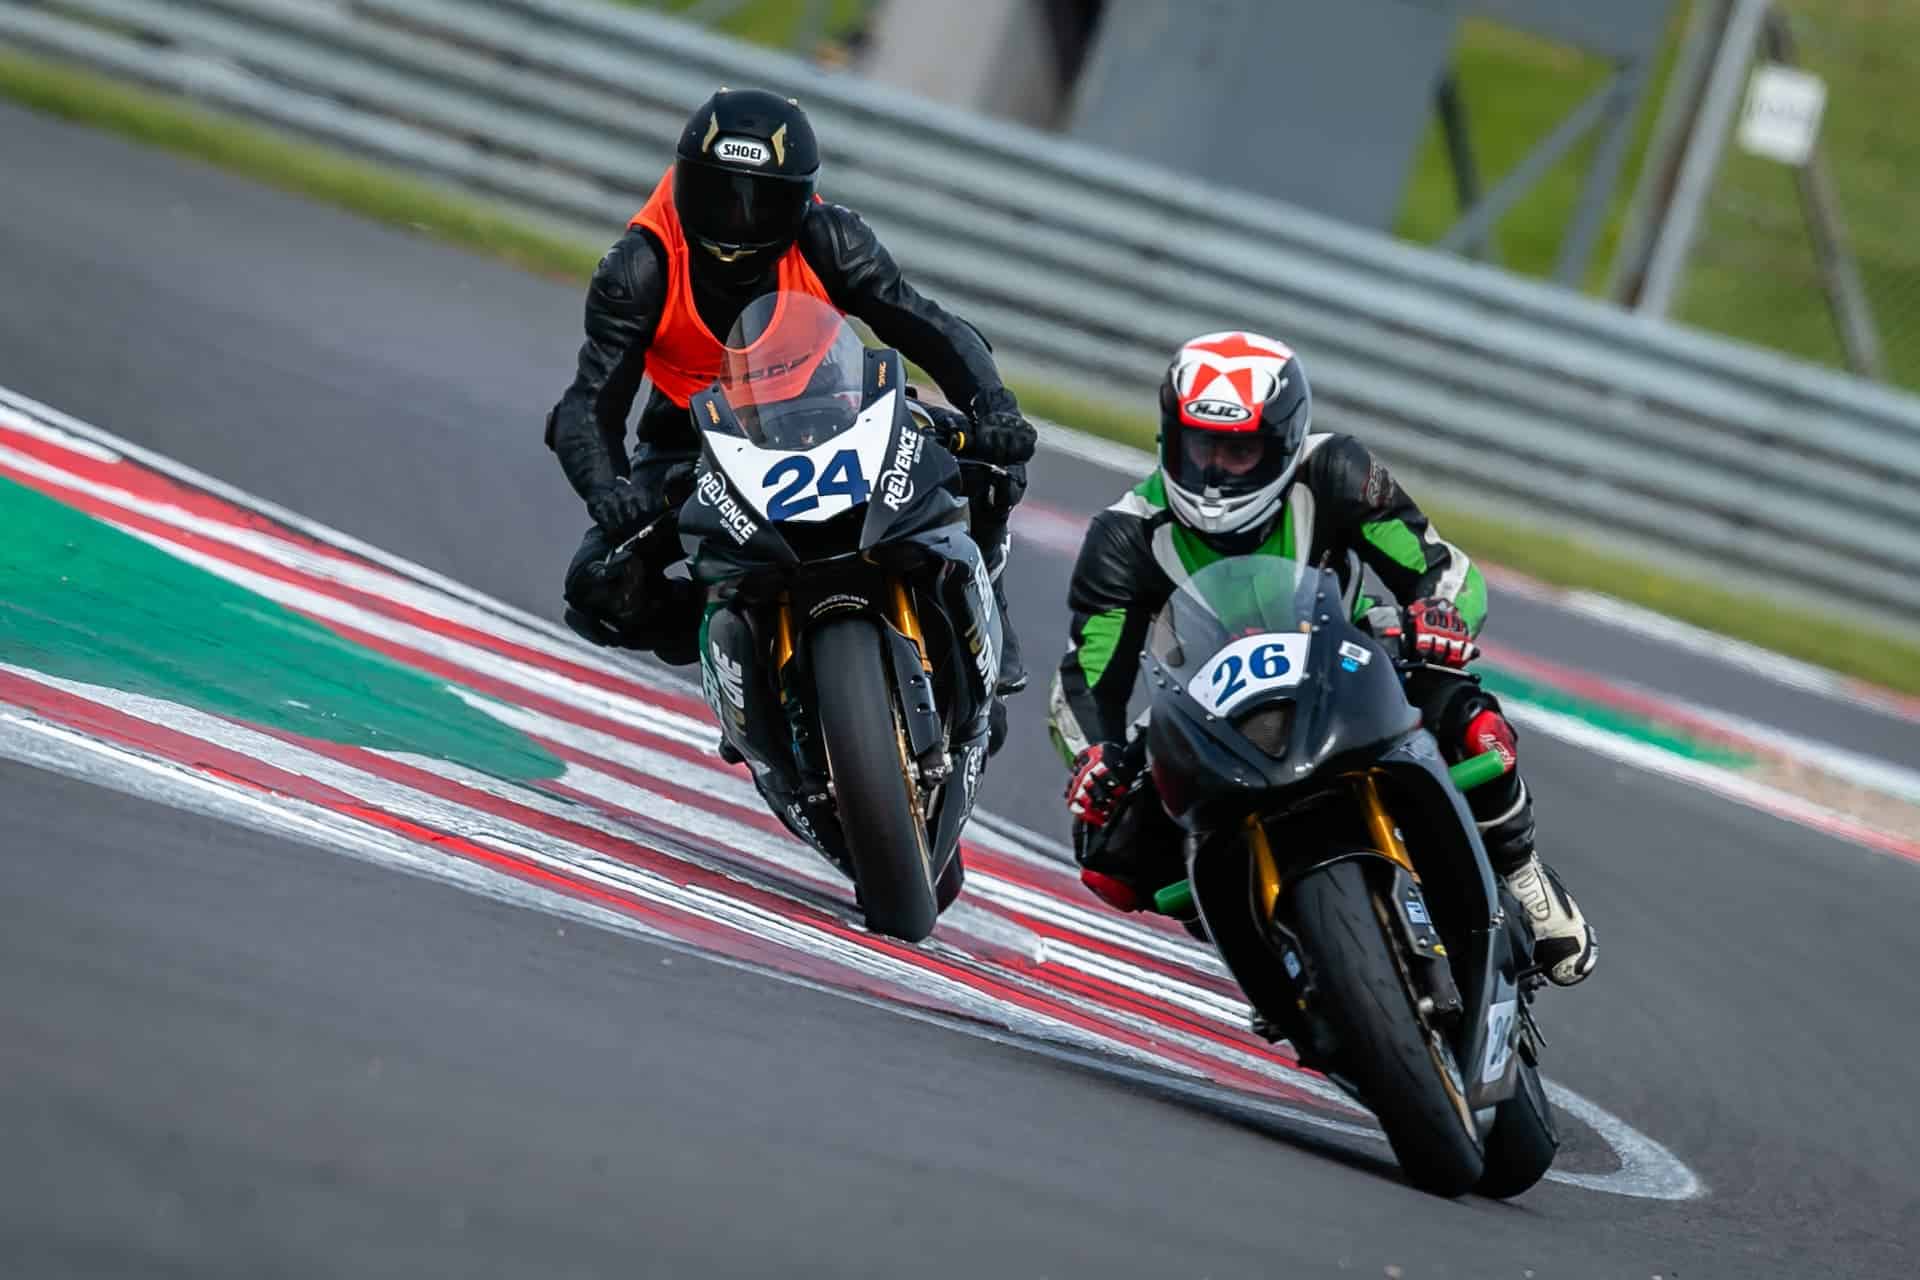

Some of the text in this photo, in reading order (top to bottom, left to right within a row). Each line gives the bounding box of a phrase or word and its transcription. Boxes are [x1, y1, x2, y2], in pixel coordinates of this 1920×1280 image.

[723, 143, 762, 160] SHOEI
[1194, 402, 1241, 418] HJC
[762, 449, 870, 520] 24
[884, 425, 917, 511] RELYENCE
[697, 471, 758, 540] RELYENCE
[1212, 643, 1291, 708] 26
